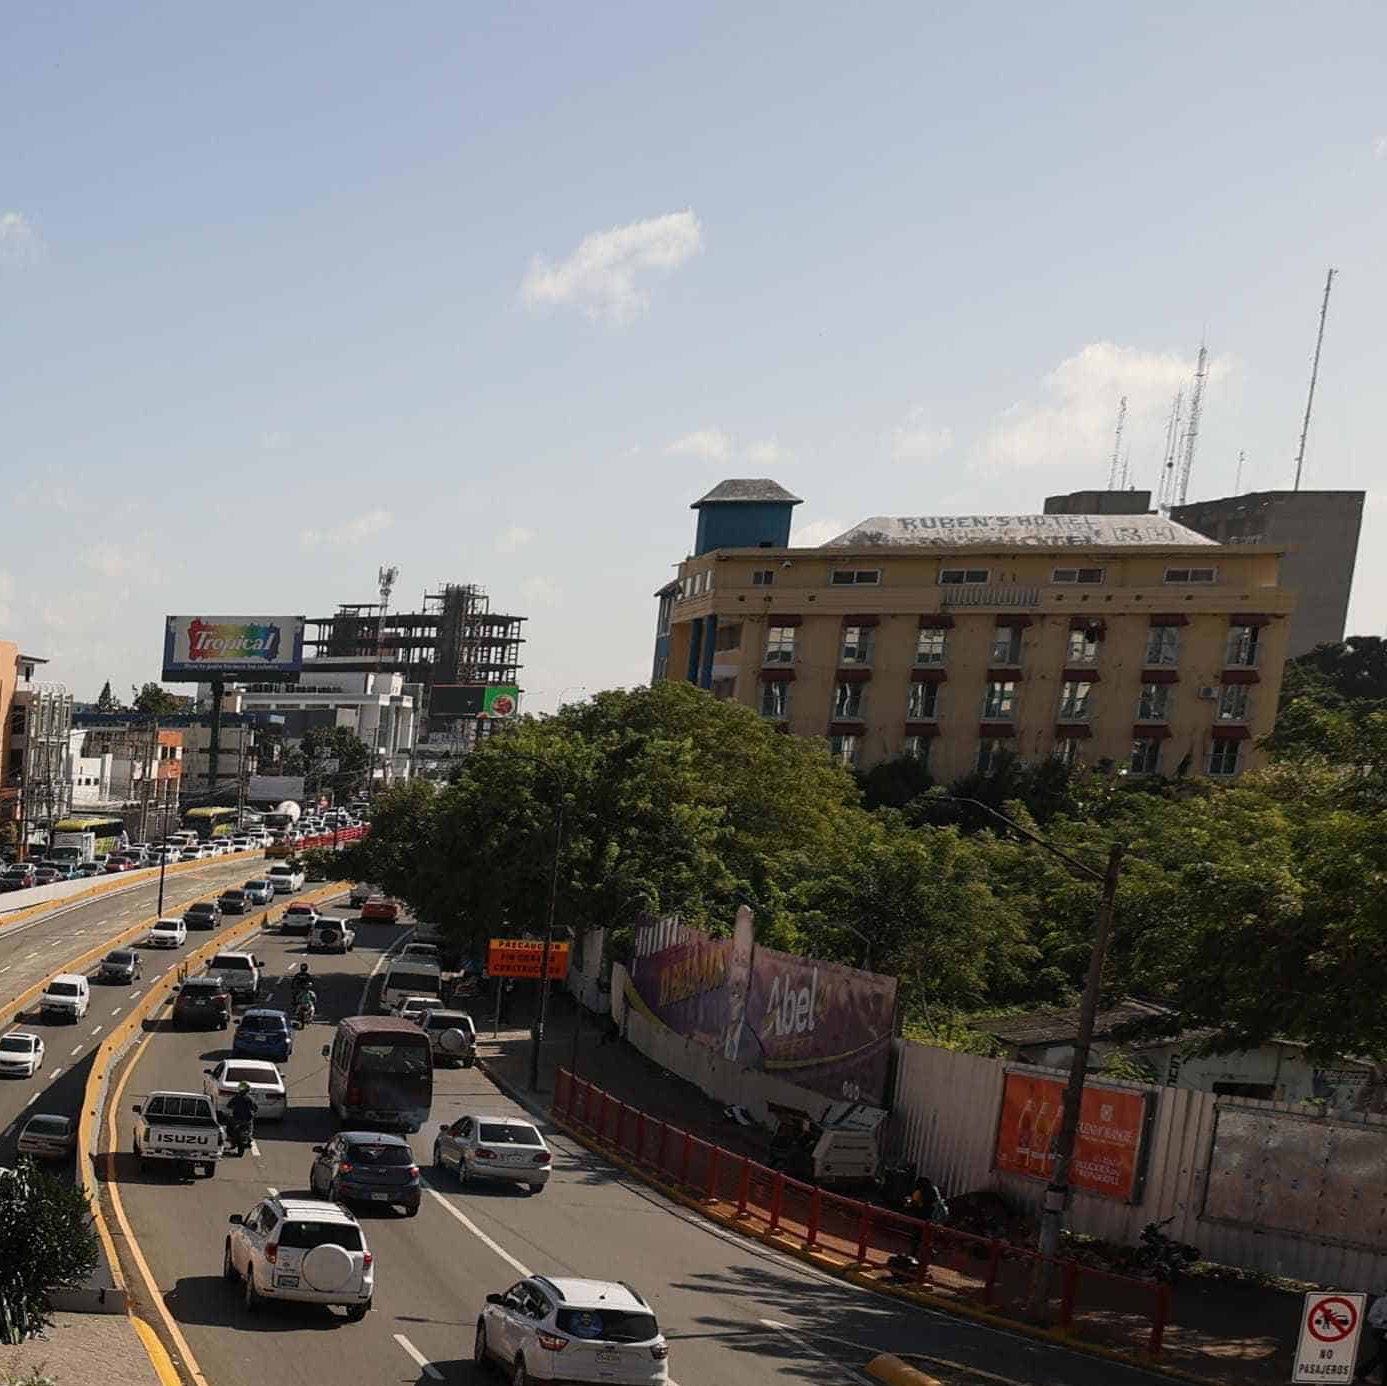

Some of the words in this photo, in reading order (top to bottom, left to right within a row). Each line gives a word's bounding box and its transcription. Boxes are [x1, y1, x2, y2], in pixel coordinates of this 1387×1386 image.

[1017, 514, 1099, 529] HOTEL
[194, 630, 276, 657] Tropical
[760, 965, 818, 1040] Abel
[157, 1133, 209, 1145] ISUZU
[1319, 1348, 1334, 1360] NO
[1298, 1363, 1350, 1376] PASAJEROS
